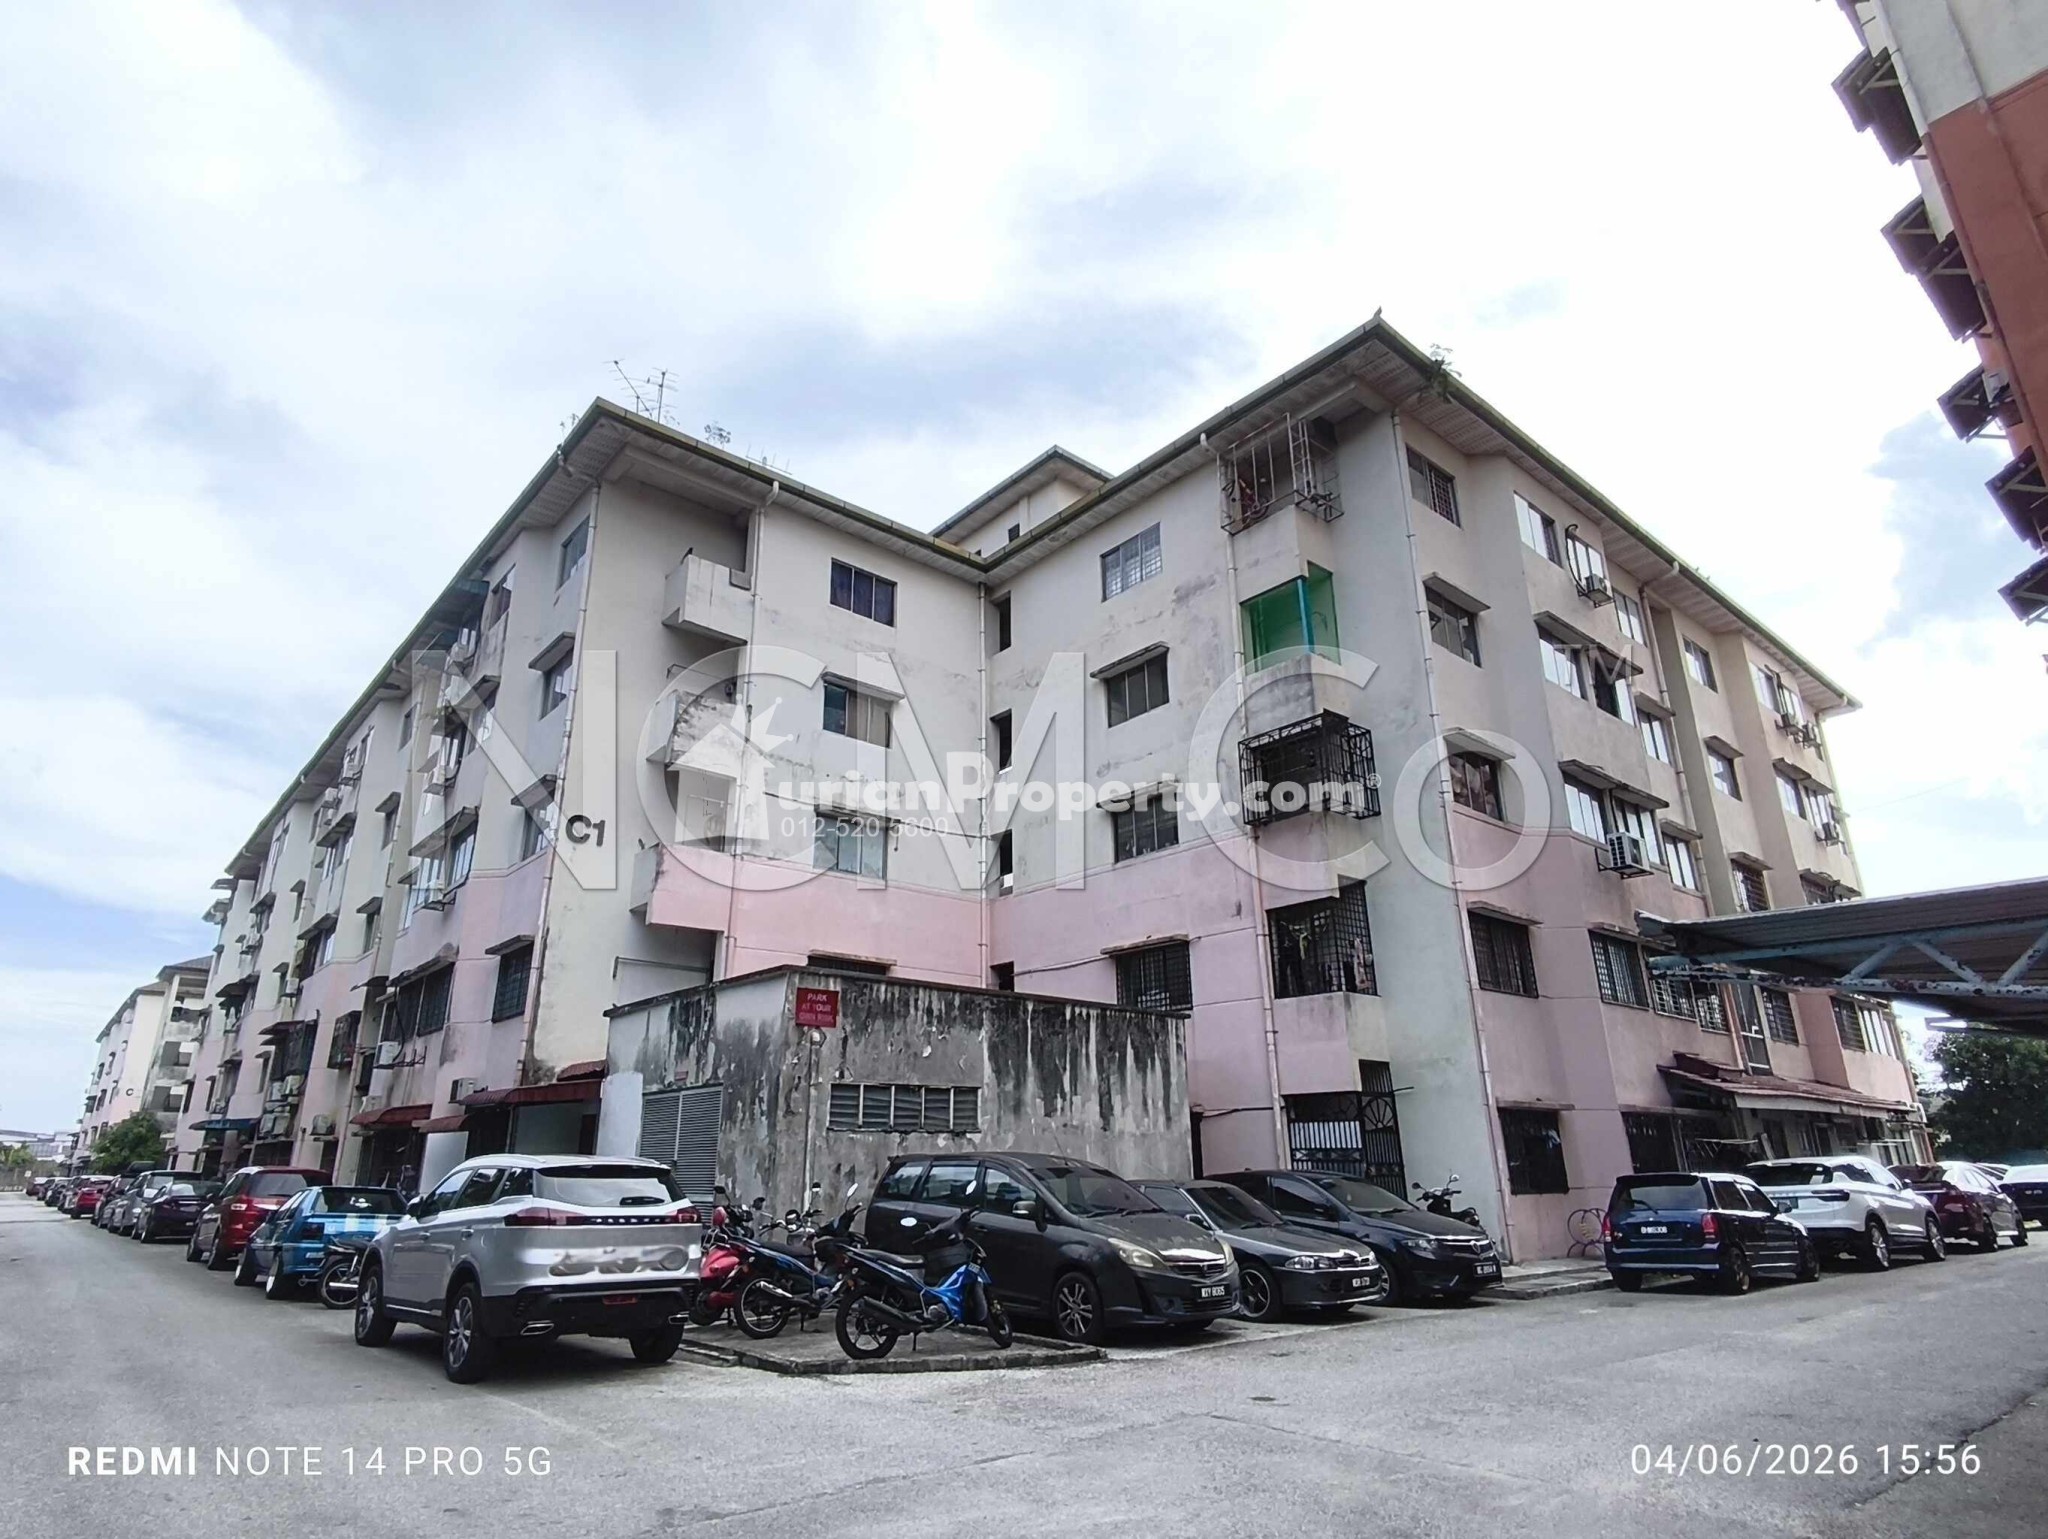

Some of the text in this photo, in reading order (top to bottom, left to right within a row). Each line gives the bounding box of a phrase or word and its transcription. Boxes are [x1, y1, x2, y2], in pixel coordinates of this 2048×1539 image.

[565, 814, 606, 847] C1
[807, 993, 828, 1002] PARK
[812, 1003, 832, 1012] YOUR
